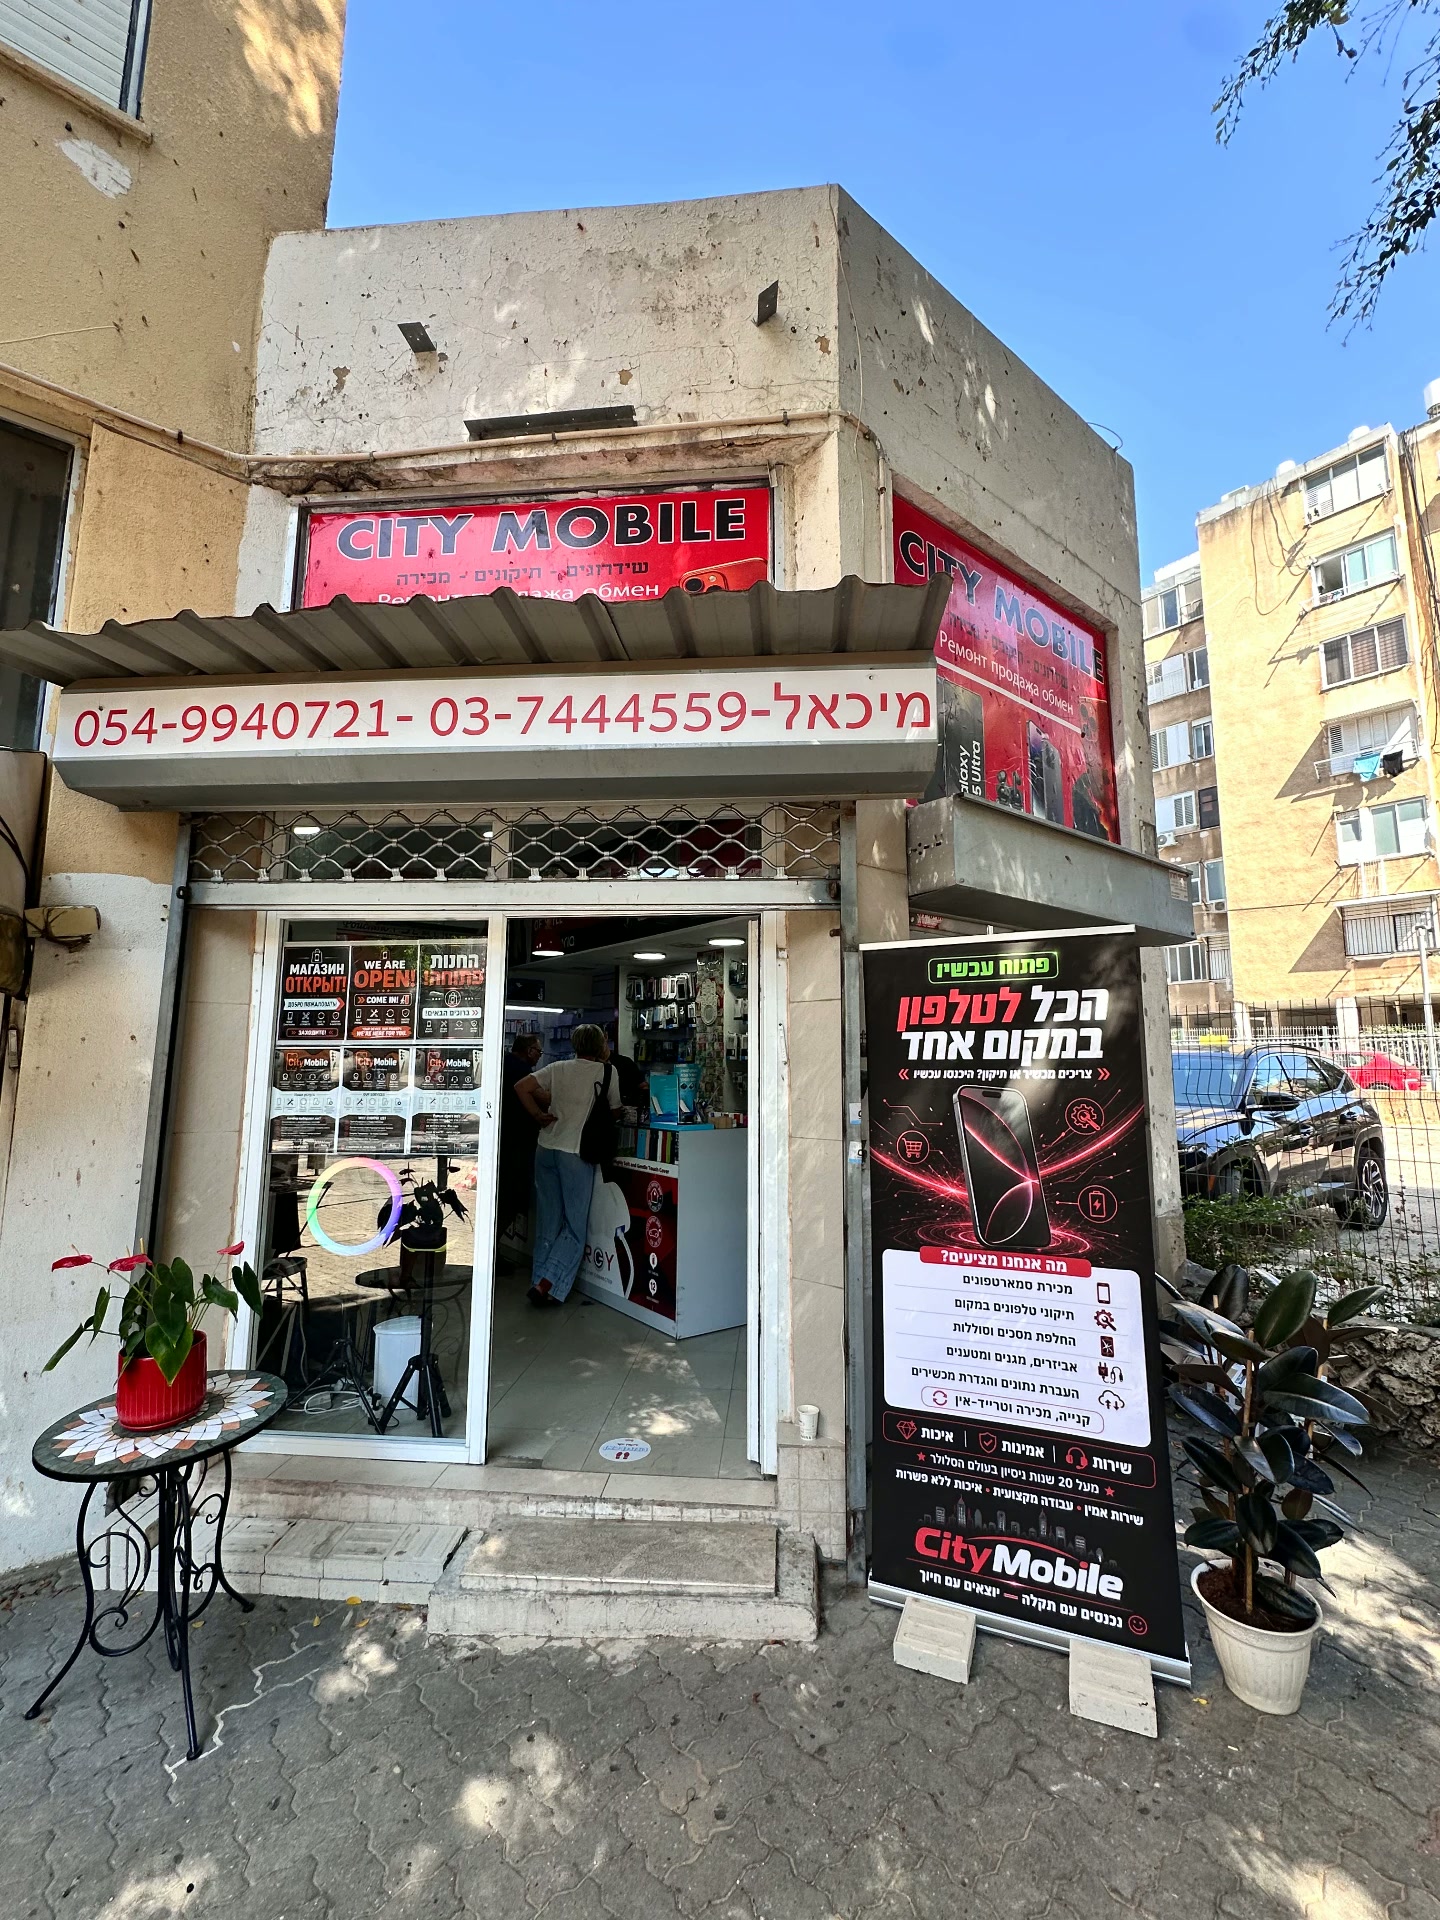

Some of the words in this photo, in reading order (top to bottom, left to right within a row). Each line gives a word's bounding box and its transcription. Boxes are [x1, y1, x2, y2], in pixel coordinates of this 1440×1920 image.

[336, 513, 475, 561] CITY
[491, 498, 746, 552] MOBILE
[474, 567, 542, 583] תיקונים
[566, 561, 649, 577] שידרוגים
[396, 571, 451, 586] מכירה
[899, 530, 983, 606] CITY
[994, 584, 1105, 685] MOBILE
[940, 630, 987, 668] Ремонт
[991, 661, 1039, 696] продажа
[1042, 689, 1074, 715] обмен
[971, 740, 981, 782] Ultra
[959, 745, 970, 794] alaxy
[289, 963, 345, 975] МАГАЗИН
[364, 960, 382, 970] WE
[383, 960, 406, 970] ARE
[430, 954, 479, 969] החנות
[936, 960, 994, 978] עכשיו
[999, 957, 1050, 975] פתוח
[285, 975, 347, 993] ОТКРЫТ!
[353, 969, 416, 988] OPEN!
[366, 996, 387, 1004] COME
[388, 996, 399, 1004] IN!
[1030, 984, 1110, 1023] הכל
[896, 986, 1023, 1032] לטלפון
[901, 1030, 976, 1060] אחד
[982, 1027, 1104, 1067] במקום
[913, 1069, 942, 1079] עכשיו
[943, 1069, 975, 1079] היכנסו
[976, 1069, 1008, 1082] תיקון?
[1009, 1069, 1021, 1079] או
[1022, 1069, 1056, 1079] מכשיר
[1058, 1069, 1093, 1079] צריכים
[940, 1249, 998, 1267] מציעים?
[1002, 1255, 1042, 1270] אנחנו
[1045, 1259, 1067, 1273] מה
[962, 1275, 1033, 1290] סמארטפונים
[1036, 1282, 1073, 1295] מכירת
[954, 1298, 990, 1312] במקום
[993, 1302, 1037, 1316] טלפונים
[1040, 1307, 1075, 1321] תיקוני
[952, 1322, 994, 1336] וסוללות
[997, 1327, 1032, 1341] מסכים
[1036, 1332, 1076, 1346] החלפת
[946, 1346, 991, 1361] ומטענים
[994, 1352, 1027, 1365] מגנים
[1030, 1357, 1078, 1373] אביזרים,
[911, 1366, 955, 1381] מכשירים
[958, 1372, 998, 1387] והגדרת
[1001, 1378, 1036, 1392] נתונים
[1039, 1384, 1080, 1399] העברת
[955, 1395, 1013, 1413] וטרייד-אין
[1016, 1404, 1051, 1419] מכירה
[1055, 1411, 1090, 1428] קנייה,
[920, 1427, 954, 1443] איכות
[1001, 1440, 1045, 1459] אמינות
[929, 1453, 965, 1469] הסלולר
[967, 1460, 998, 1475] בעולם
[1092, 1456, 1132, 1475] שירות
[895, 1468, 929, 1483] פשרות
[930, 1474, 951, 1487] ללא
[1000, 1466, 1027, 1480] ניסיון
[1029, 1471, 1055, 1485] שנות
[953, 1479, 983, 1494] איכות
[1057, 1476, 1073, 1489] 20
[1076, 1478, 1100, 1494] מעל
[992, 1486, 1039, 1505] מקצועית
[1040, 1495, 1074, 1511] עבודה
[1084, 1504, 1108, 1519] אמין
[1110, 1509, 1144, 1526] שירות
[918, 1568, 942, 1585] חיוך
[944, 1575, 961, 1589] עם
[963, 1579, 1000, 1597] יוצאים
[1021, 1593, 1057, 1613] תקלה
[1059, 1602, 1077, 1617] עם
[1080, 1606, 1123, 1629] נכנסים
